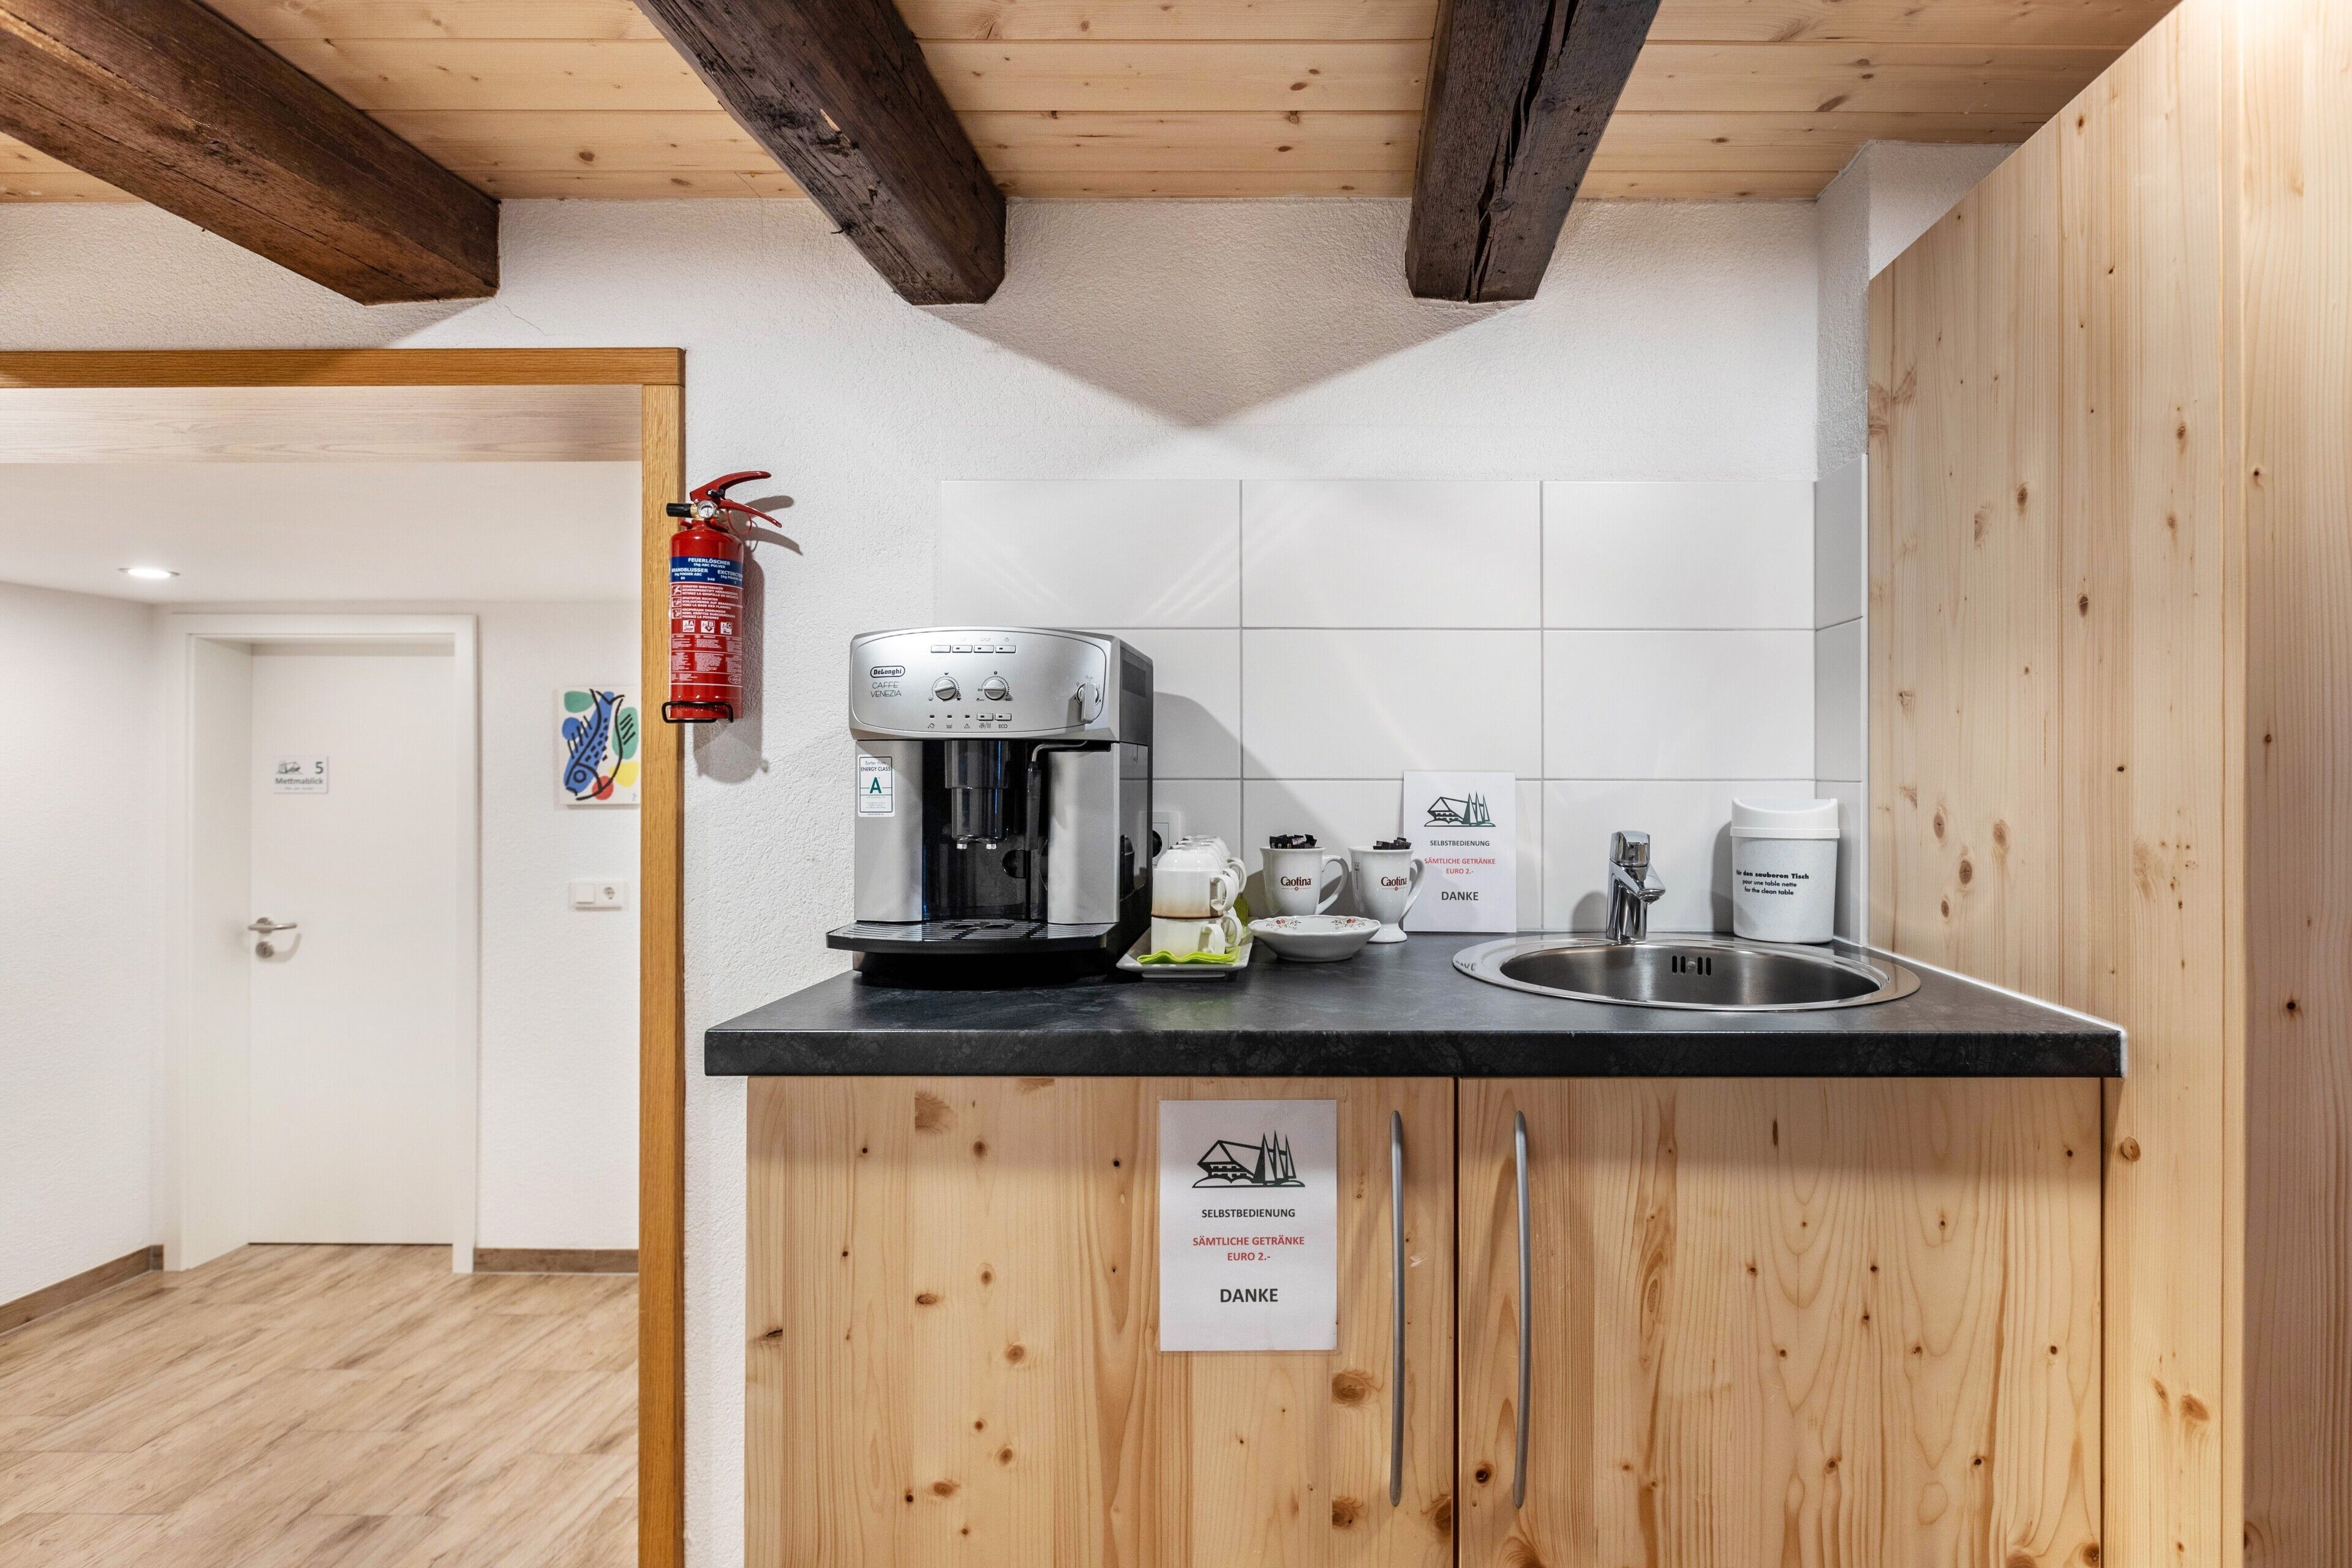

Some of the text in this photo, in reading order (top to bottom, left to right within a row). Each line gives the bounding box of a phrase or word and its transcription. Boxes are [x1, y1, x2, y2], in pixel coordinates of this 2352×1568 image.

[688, 557, 731, 566] FEUERLÖSCHER
[315, 761, 323, 774] 5
[870, 777, 881, 793] A
[1281, 876, 1311, 886] Caotina
[1381, 876, 1407, 886] Caotina
[1441, 892, 1479, 900] DANKE
[1202, 1208, 1295, 1218] SELBSTBEDIENUNG
[1193, 1235, 1305, 1246] SÄMTLICHE GETRÄNKE
[1258, 1252, 1270, 1261] 2.-
[1220, 1288, 1278, 1302] DANKE
